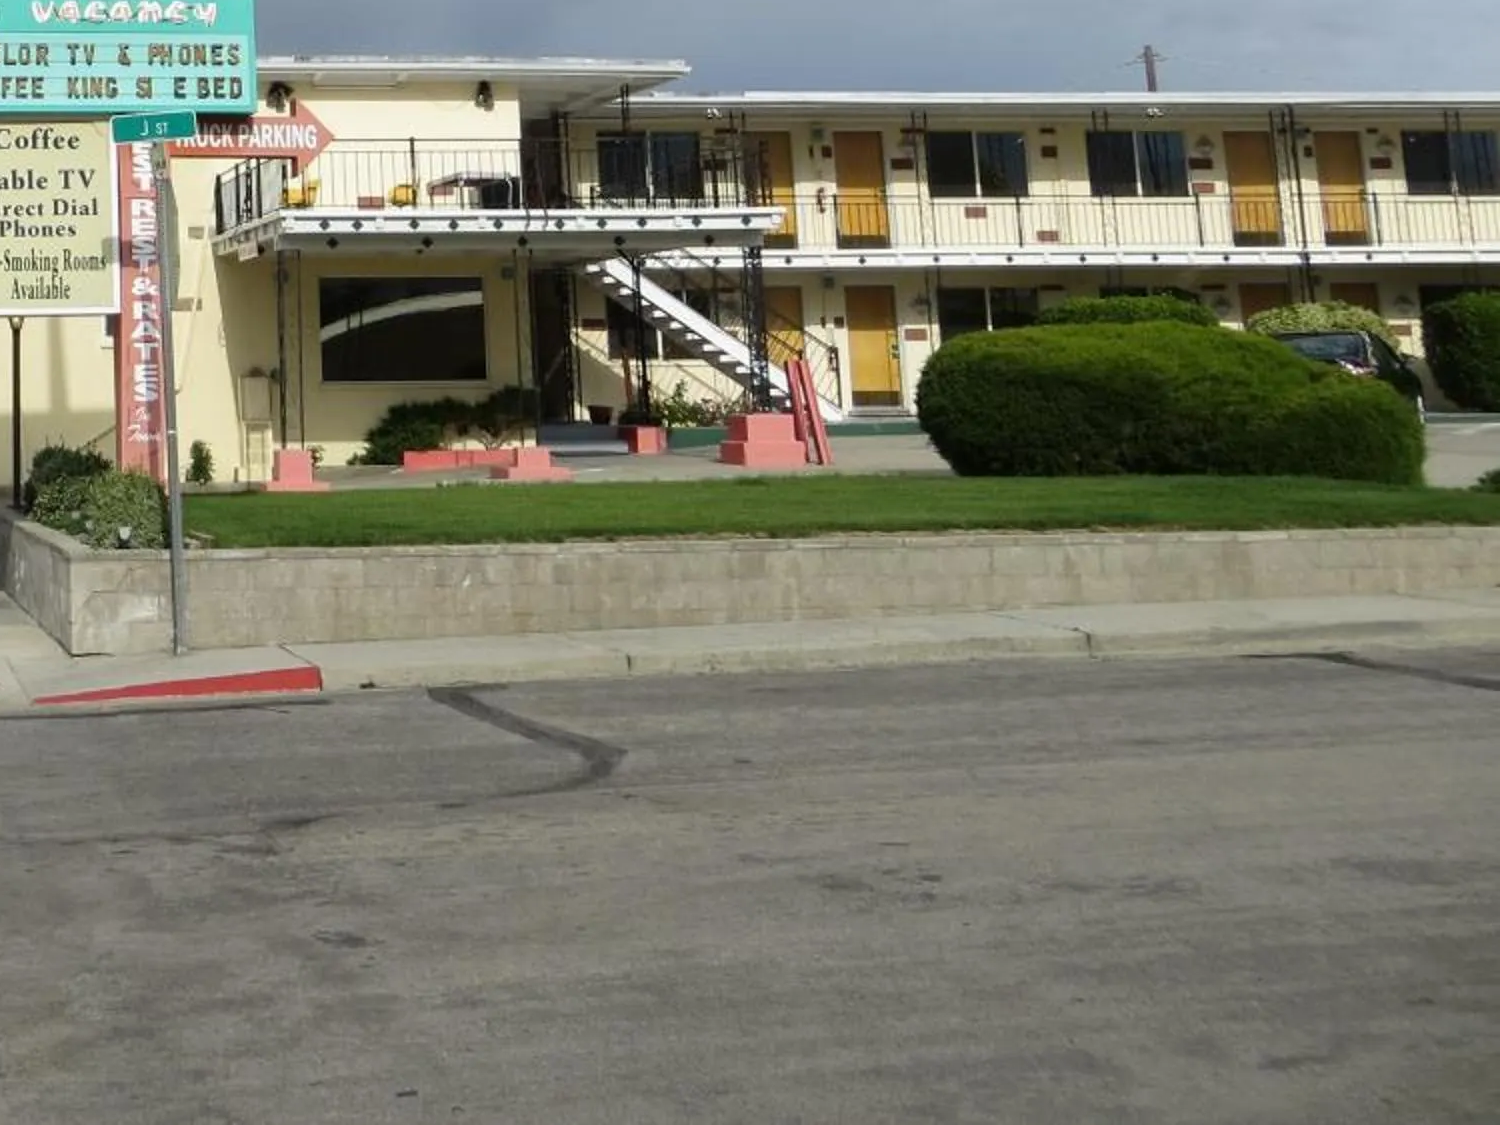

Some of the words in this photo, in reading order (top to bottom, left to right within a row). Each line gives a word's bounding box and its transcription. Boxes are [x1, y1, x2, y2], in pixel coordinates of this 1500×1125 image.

[67, 43, 96, 66] TV
[117, 43, 131, 67] &
[148, 43, 241, 67] PHONES
[67, 77, 119, 99] KING
[197, 76, 243, 99] BED
[155, 122, 169, 135] ST
[238, 123, 317, 150] PARKING
[58, 169, 96, 190] TV
[52, 197, 99, 216] Dial
[0, 219, 77, 238] Phones
[131, 199, 158, 273] REST
[62, 248, 107, 272] Rooms
[11, 276, 71, 300] Available
[131, 276, 159, 296] &
[131, 300, 160, 402] RATES
